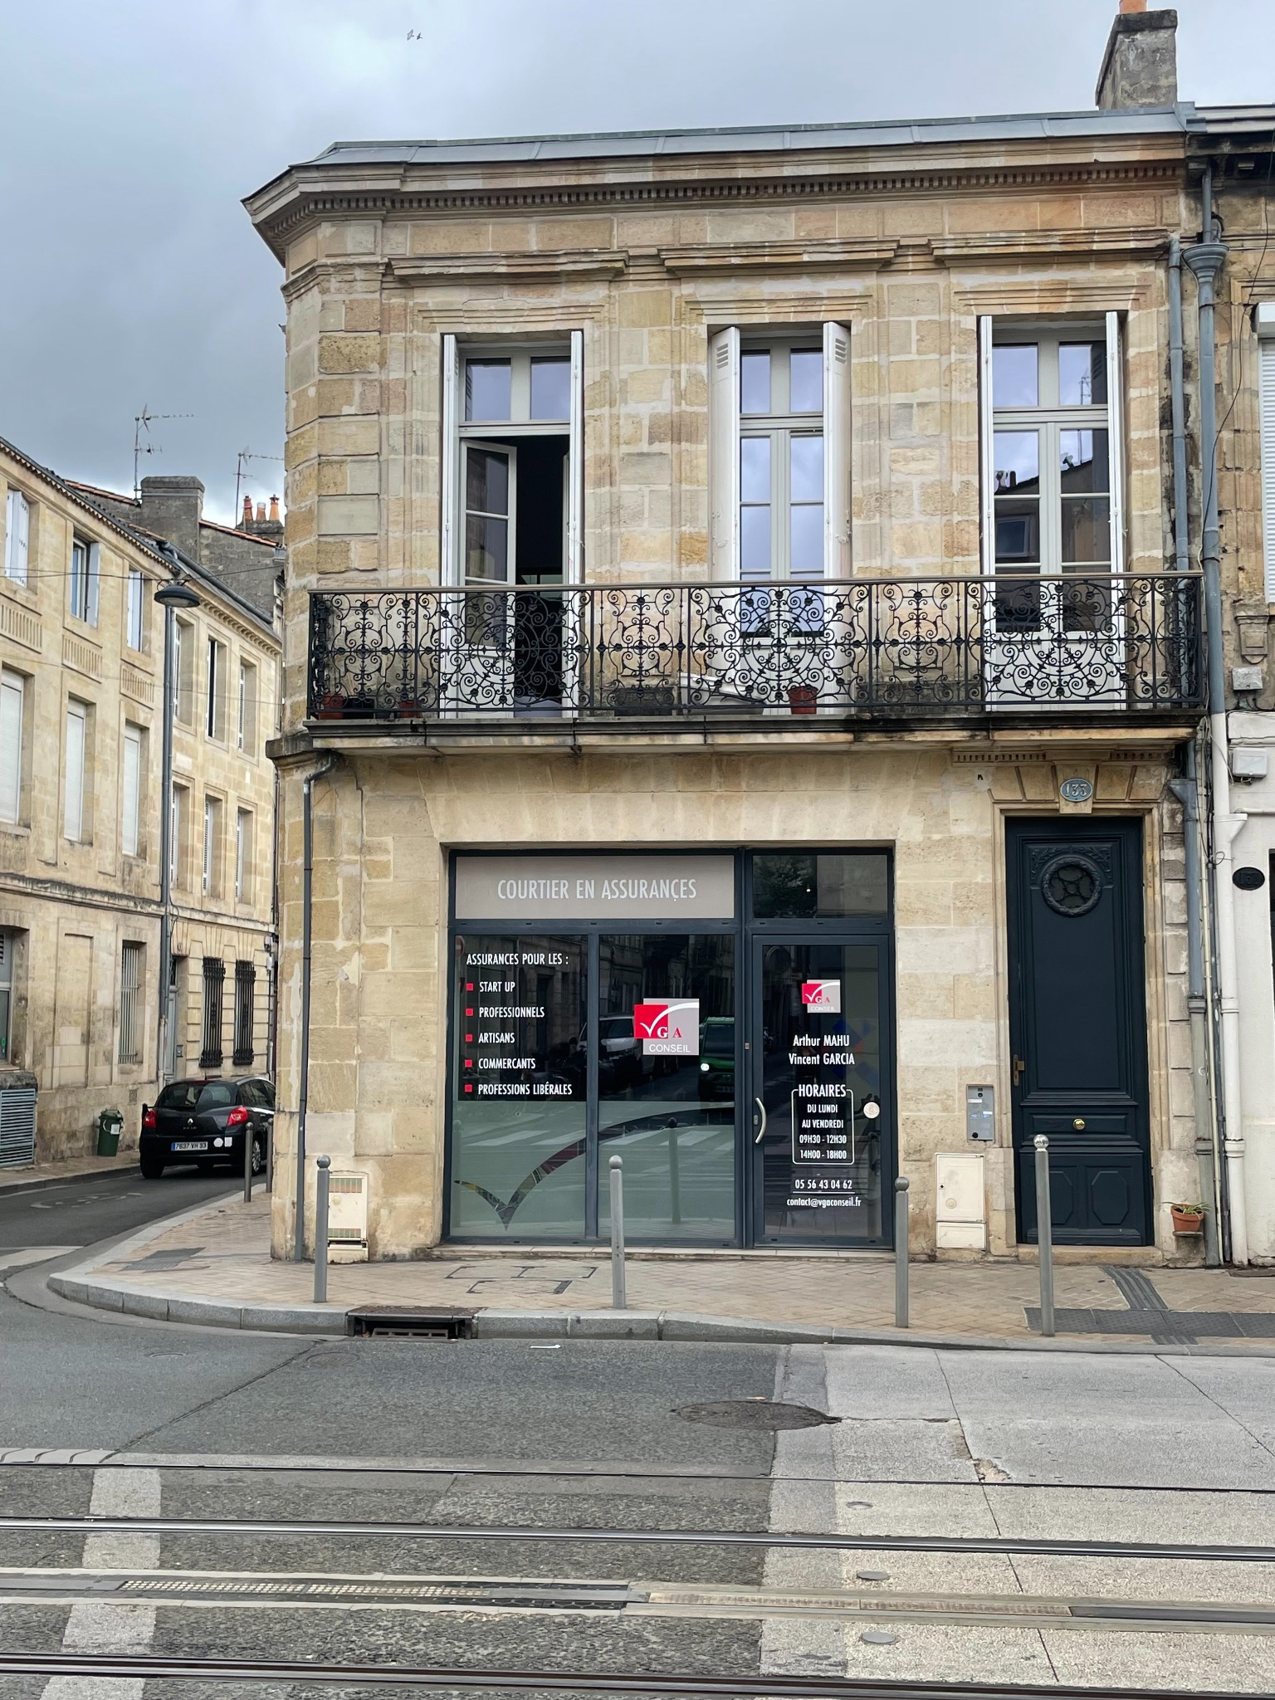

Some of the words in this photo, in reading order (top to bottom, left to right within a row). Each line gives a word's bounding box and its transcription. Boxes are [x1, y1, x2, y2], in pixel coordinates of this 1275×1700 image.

[1065, 783, 1088, 797] 133
[497, 879, 569, 899] COURTIER
[576, 879, 595, 899] EN
[466, 953, 519, 965] ASSURANCES
[522, 953, 546, 965] POUR
[548, 953, 563, 965] LES
[479, 981, 503, 993] START
[504, 981, 516, 993] UP
[479, 1007, 545, 1018] PROFESSIONNELS
[478, 1032, 516, 1044] ARTISANS
[792, 1034, 821, 1047] Arthur
[823, 1034, 851, 1047] MAHU
[648, 1043, 692, 1053] CONSEIL
[478, 1058, 537, 1070] COMMERCANTS
[788, 1052, 820, 1065] Vincent
[823, 1052, 856, 1065] GARCIA
[478, 1084, 531, 1095] PROFESSIONS
[532, 1081, 573, 1095] LIBÉRALES
[798, 1084, 847, 1098] HORAIRES
[807, 1103, 817, 1114] DU
[818, 1103, 839, 1114] LUNDI
[801, 1119, 811, 1129] AU
[812, 1119, 844, 1129] VENDREDI
[799, 1134, 821, 1144] 09H30
[826, 1134, 847, 1144] 12H30
[800, 1149, 821, 1160] 14H00
[826, 1149, 847, 1160] 18H00
[794, 1179, 805, 1190] 05
[807, 1179, 817, 1190] 56
[818, 1179, 829, 1190] 43
[830, 1179, 841, 1190] 04
[842, 1179, 853, 1190] 62
[786, 1196, 861, 1209] contact@vgaconseil.fr
